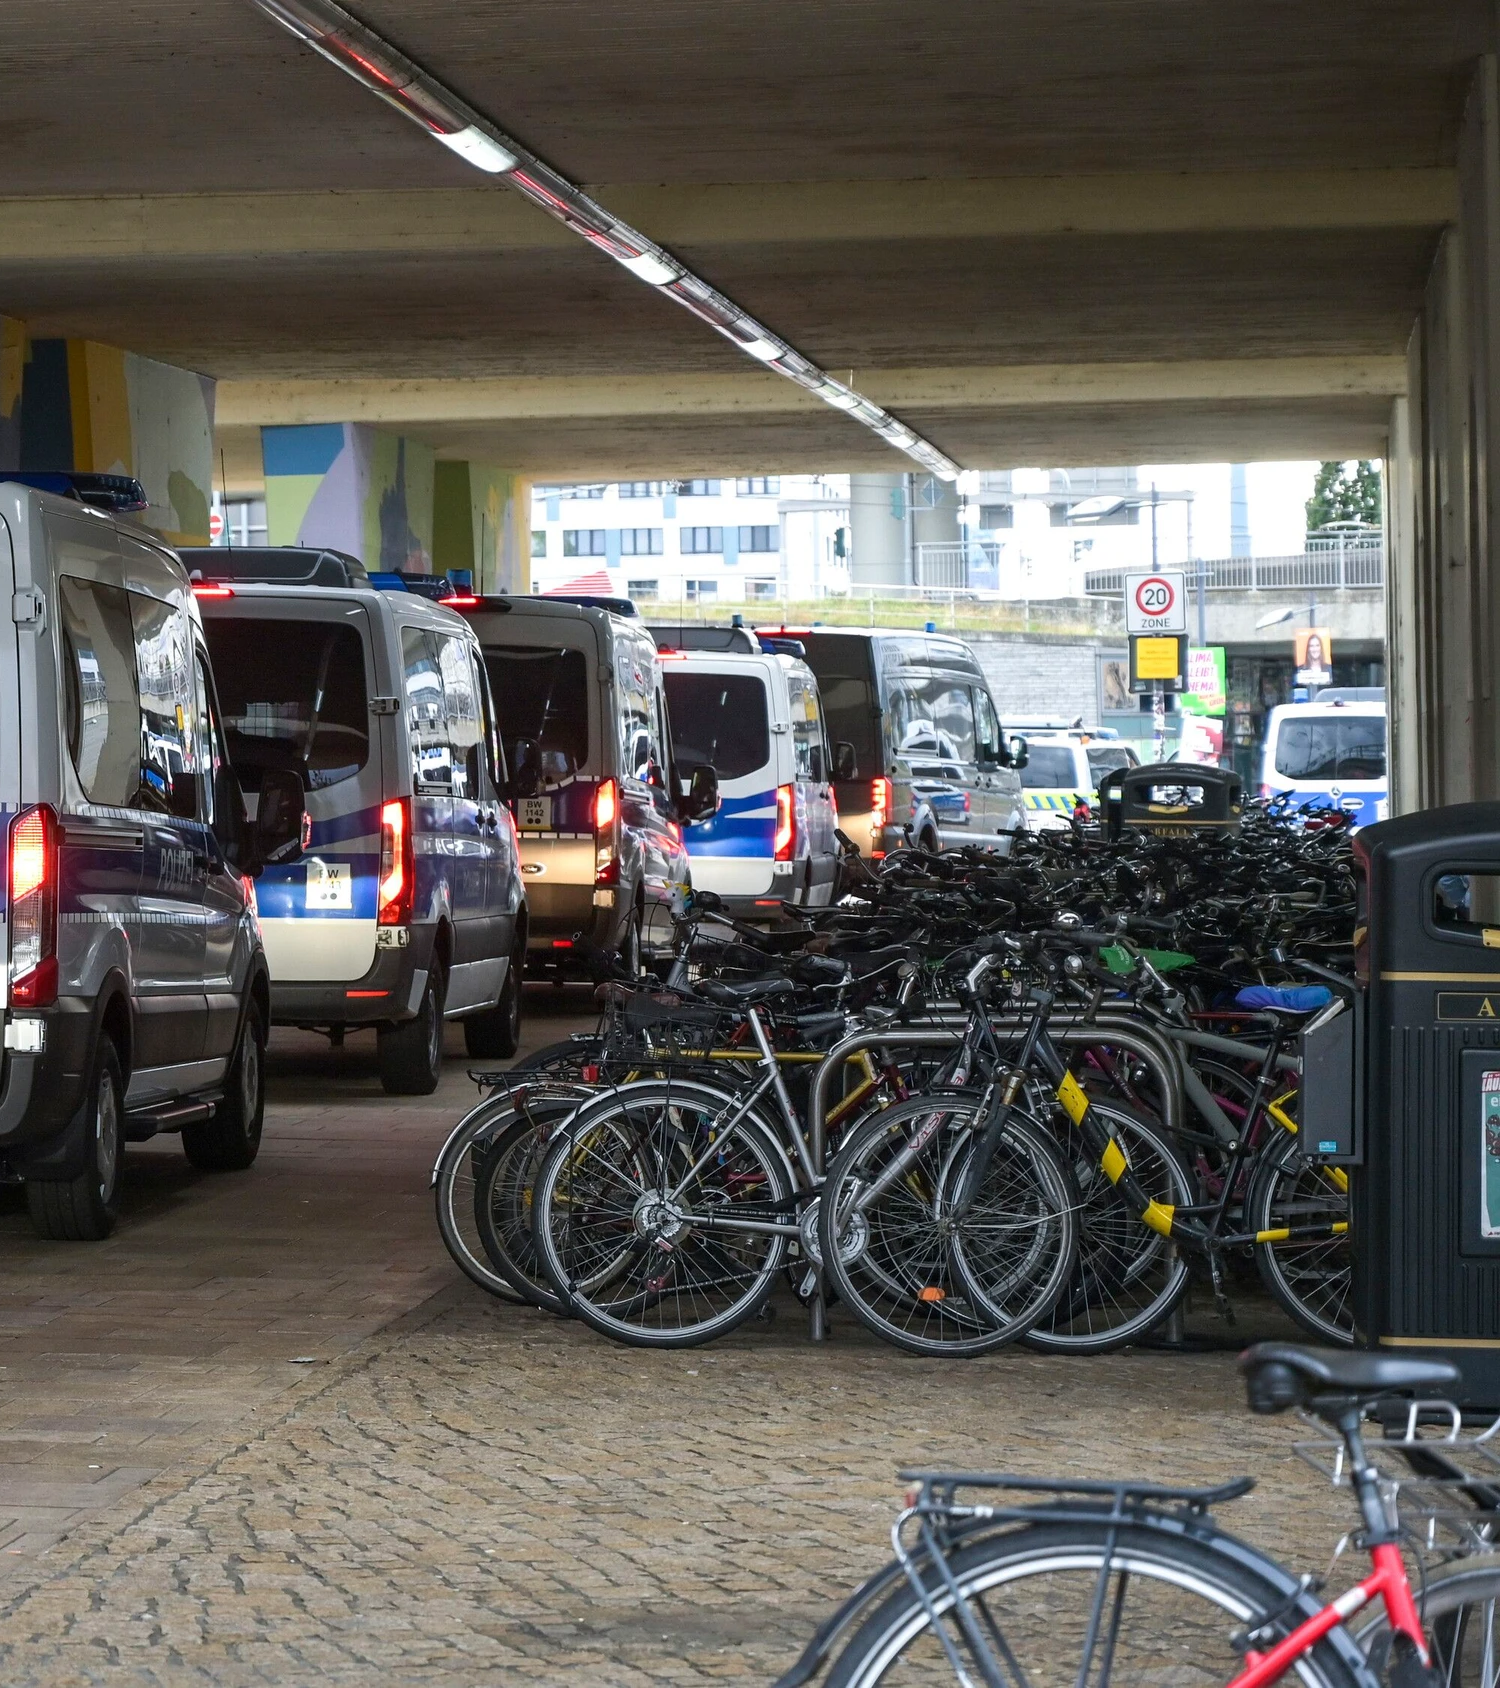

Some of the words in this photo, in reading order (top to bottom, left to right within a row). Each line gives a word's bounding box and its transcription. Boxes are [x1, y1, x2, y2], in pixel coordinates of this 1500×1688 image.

[1145, 588, 1167, 605] 20
[1141, 618, 1171, 628] ZONE
[1189, 653, 1212, 663] LIMA
[1189, 667, 1214, 677] LEIBT
[526, 800, 543, 808] BW
[524, 809, 544, 817] 1142
